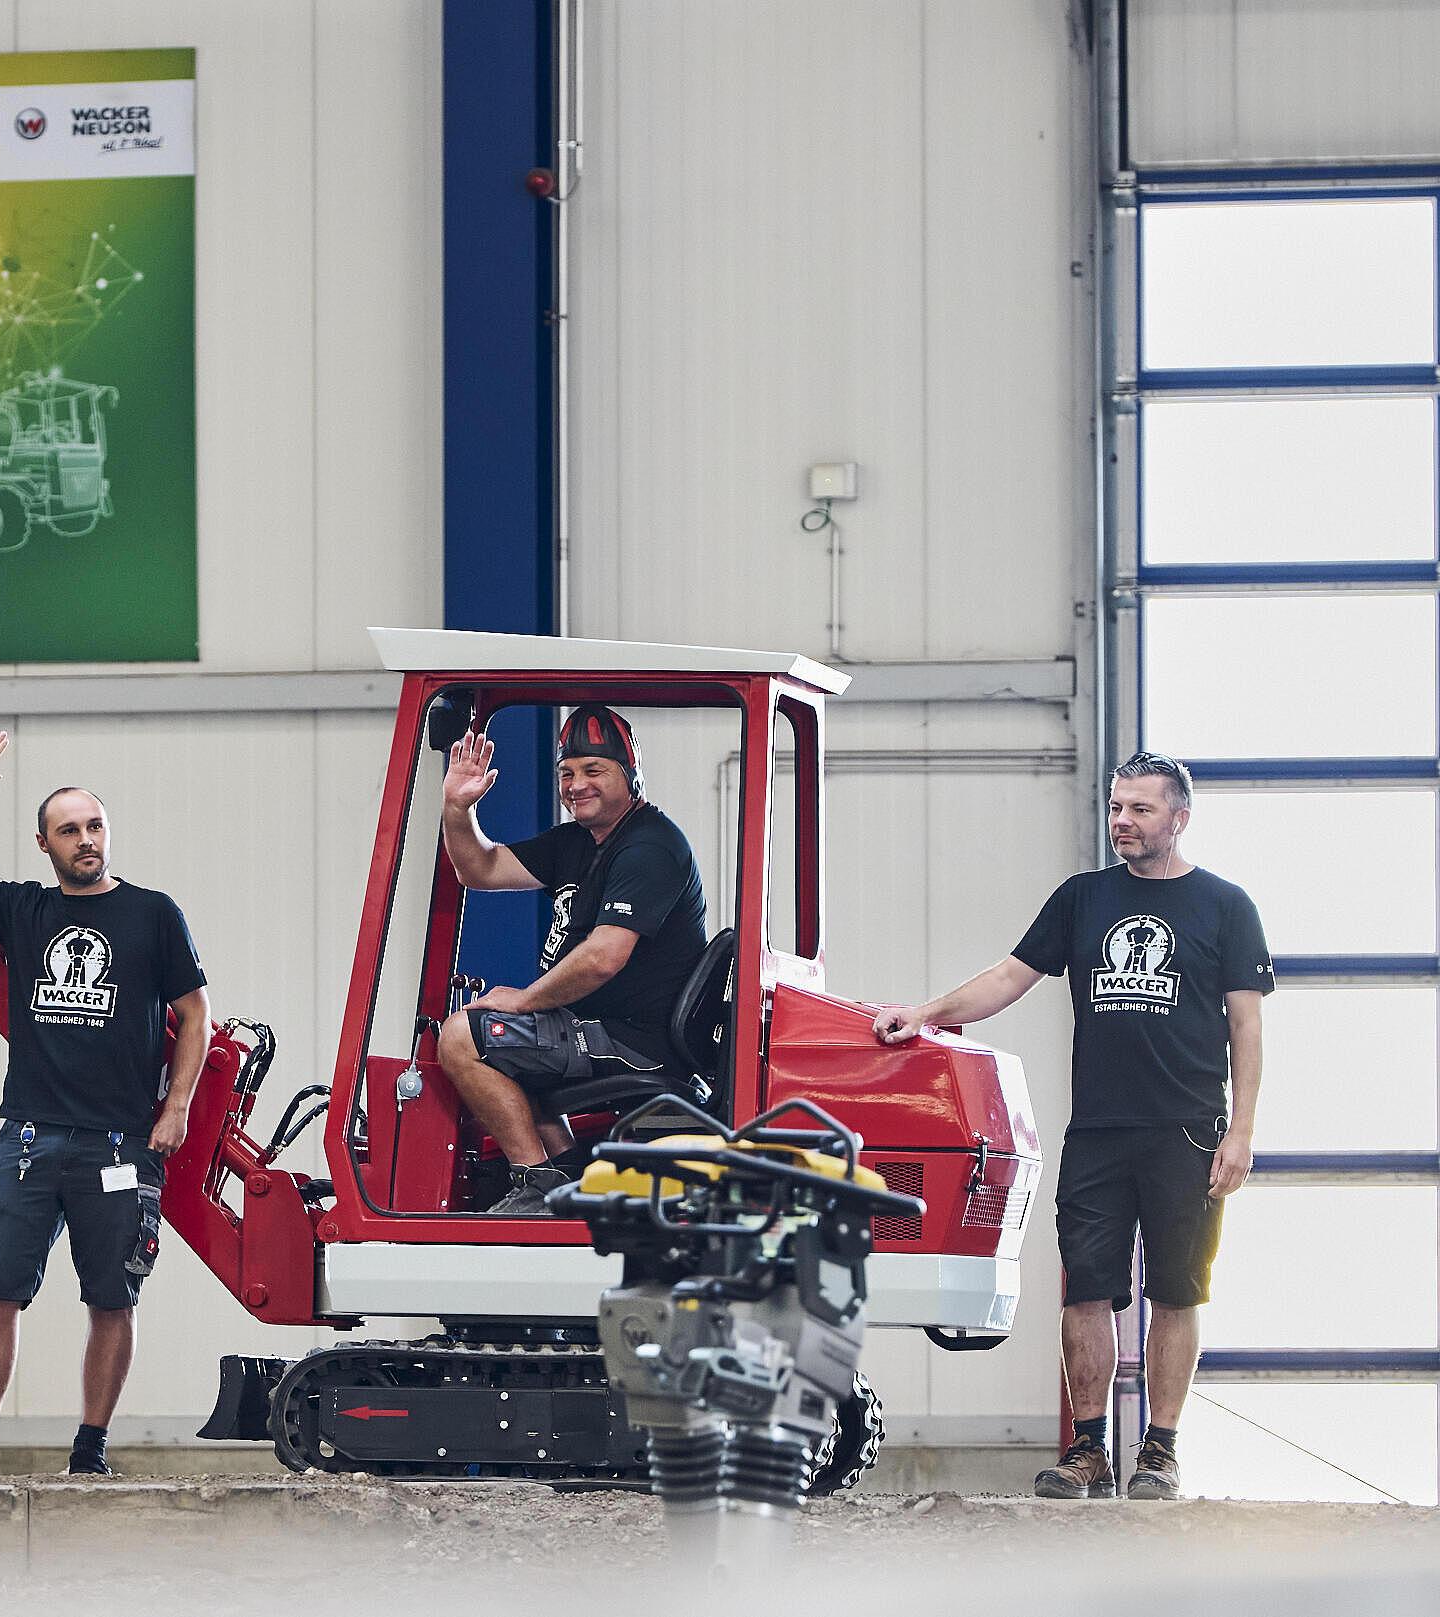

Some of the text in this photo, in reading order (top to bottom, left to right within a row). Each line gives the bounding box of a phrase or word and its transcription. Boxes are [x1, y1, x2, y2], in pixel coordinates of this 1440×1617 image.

[71, 106, 150, 120] WACKER
[72, 120, 151, 135] NEUSON
[1100, 977, 1169, 994] WACKER
[43, 989, 105, 1006] WACKER
[1094, 1003, 1148, 1013] ESTABLISHED
[34, 1013, 85, 1026] ESTABLISHED
